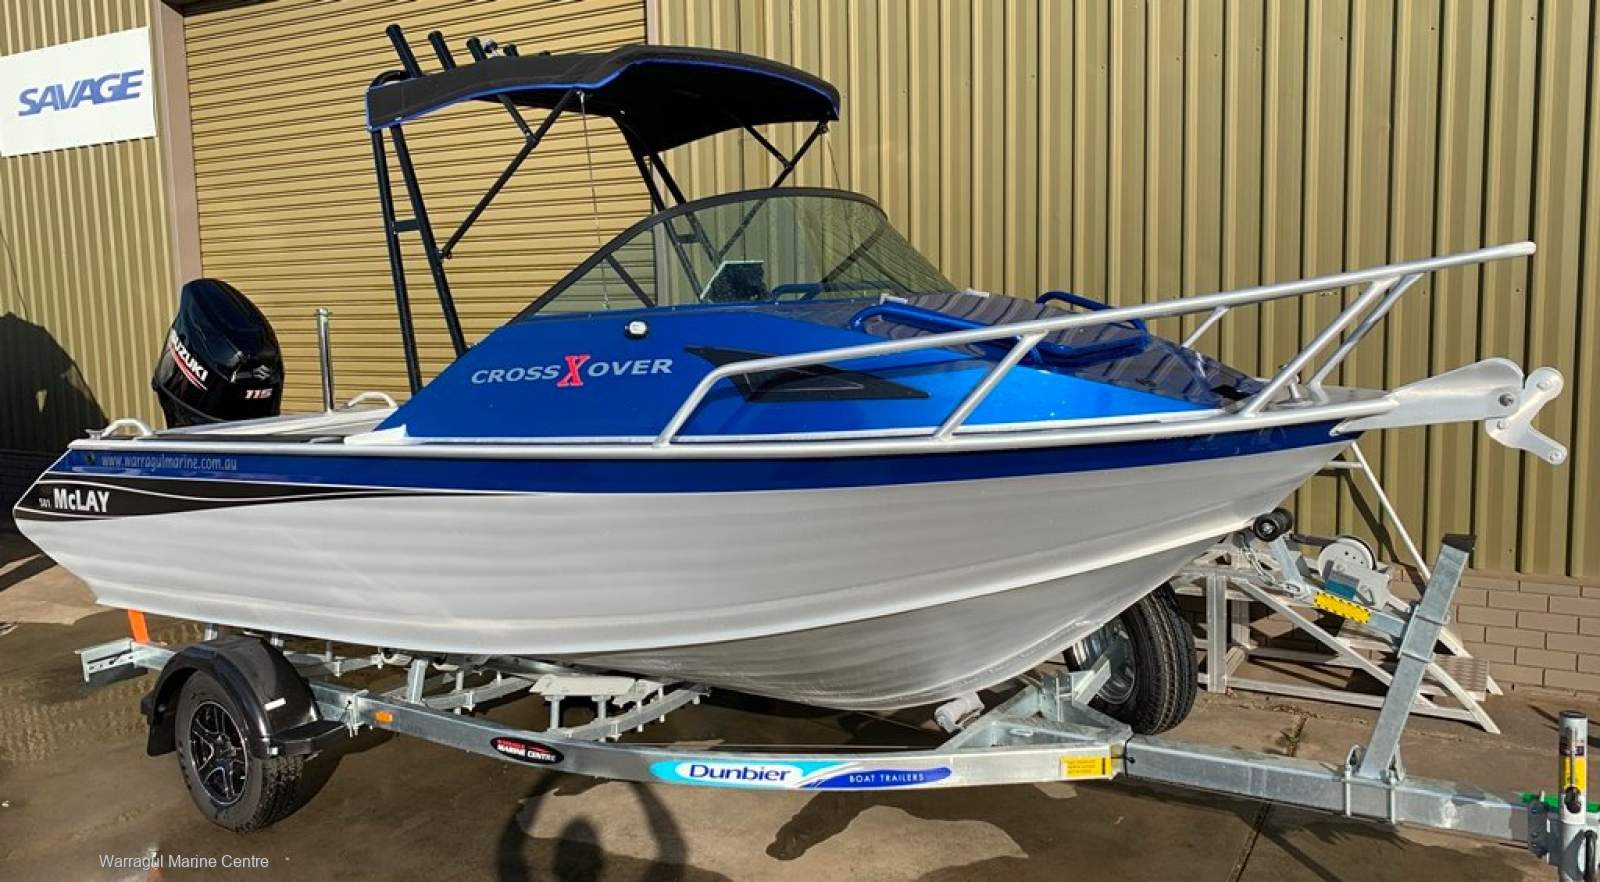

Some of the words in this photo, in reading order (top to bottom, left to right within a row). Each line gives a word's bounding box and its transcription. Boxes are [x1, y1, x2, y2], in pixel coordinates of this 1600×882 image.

[18, 70, 145, 116] SAVAGE
[245, 388, 272, 399] 115
[101, 453, 238, 472] www.warragulmarine.com.au
[53, 488, 110, 513] McLAY
[690, 764, 791, 781] Dunbier
[850, 775, 875, 783] BOAT
[879, 773, 924, 782] TRAILERS
